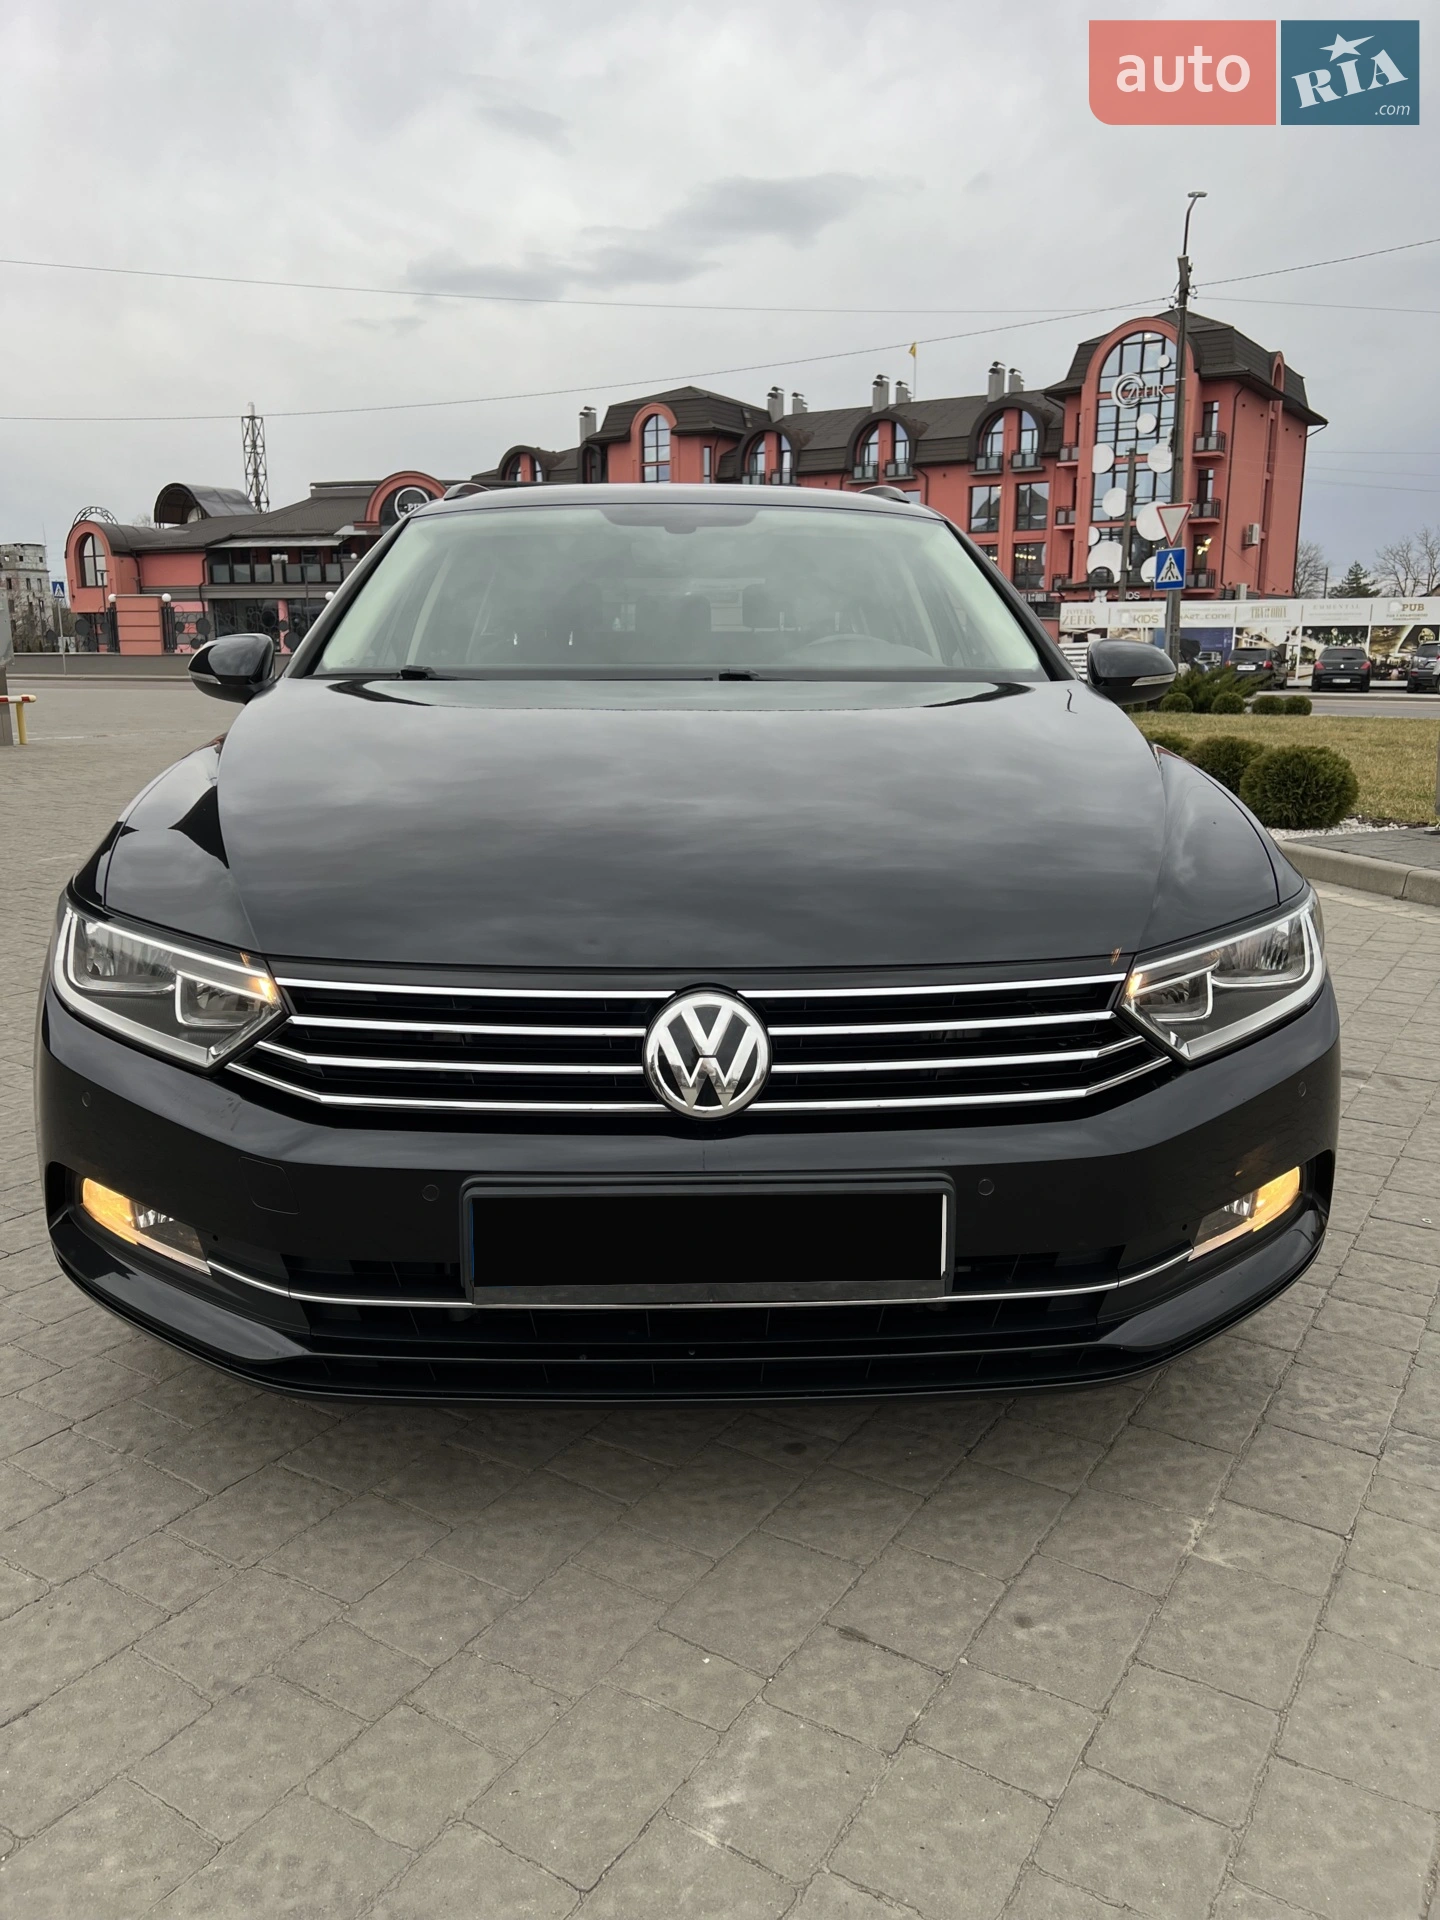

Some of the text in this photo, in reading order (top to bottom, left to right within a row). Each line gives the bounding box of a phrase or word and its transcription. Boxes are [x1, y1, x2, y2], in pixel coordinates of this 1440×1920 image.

[1126, 385, 1171, 400] ZEFIR
[1401, 603, 1425, 612] PUB
[1062, 615, 1097, 625] ZEFIR
[1133, 614, 1160, 624] KIDS
